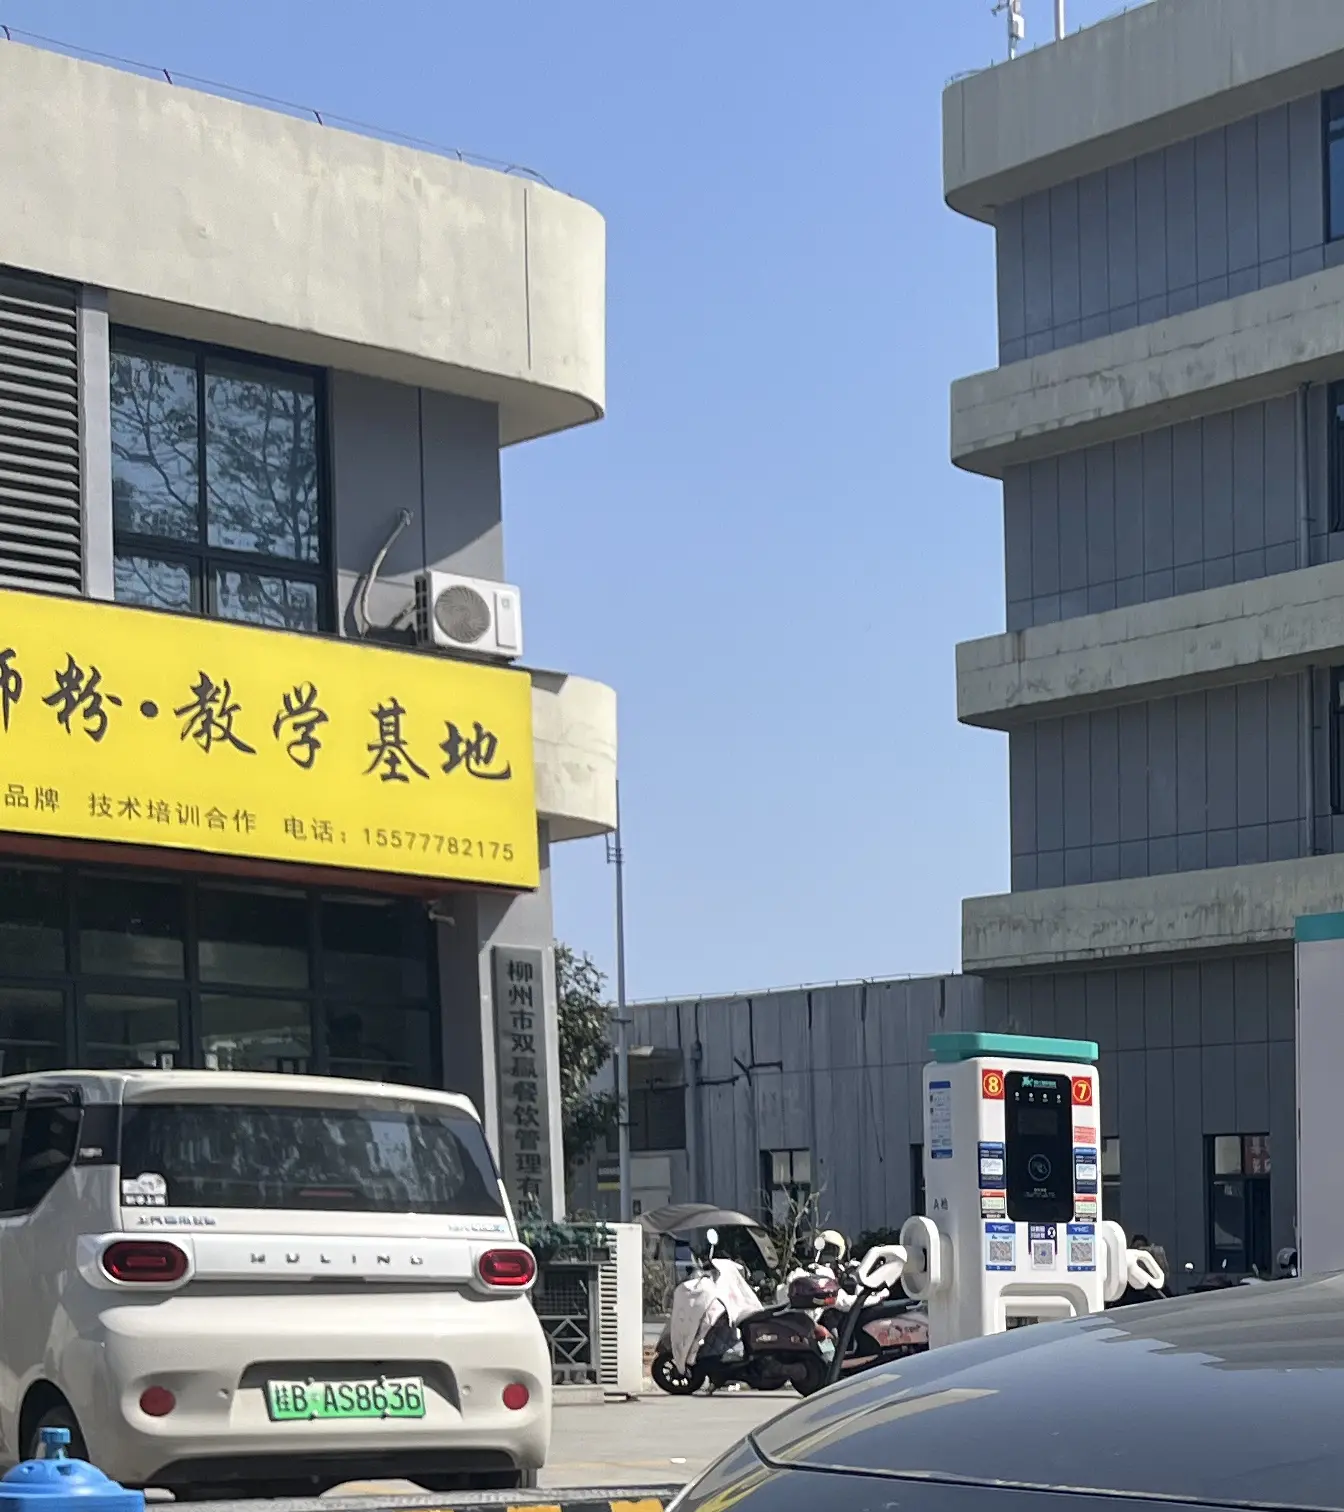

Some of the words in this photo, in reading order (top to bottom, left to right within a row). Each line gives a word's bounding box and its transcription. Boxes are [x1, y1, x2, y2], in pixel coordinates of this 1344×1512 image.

[4, 783, 60, 813] 品牌
[88, 791, 257, 834] 技术培训合作
